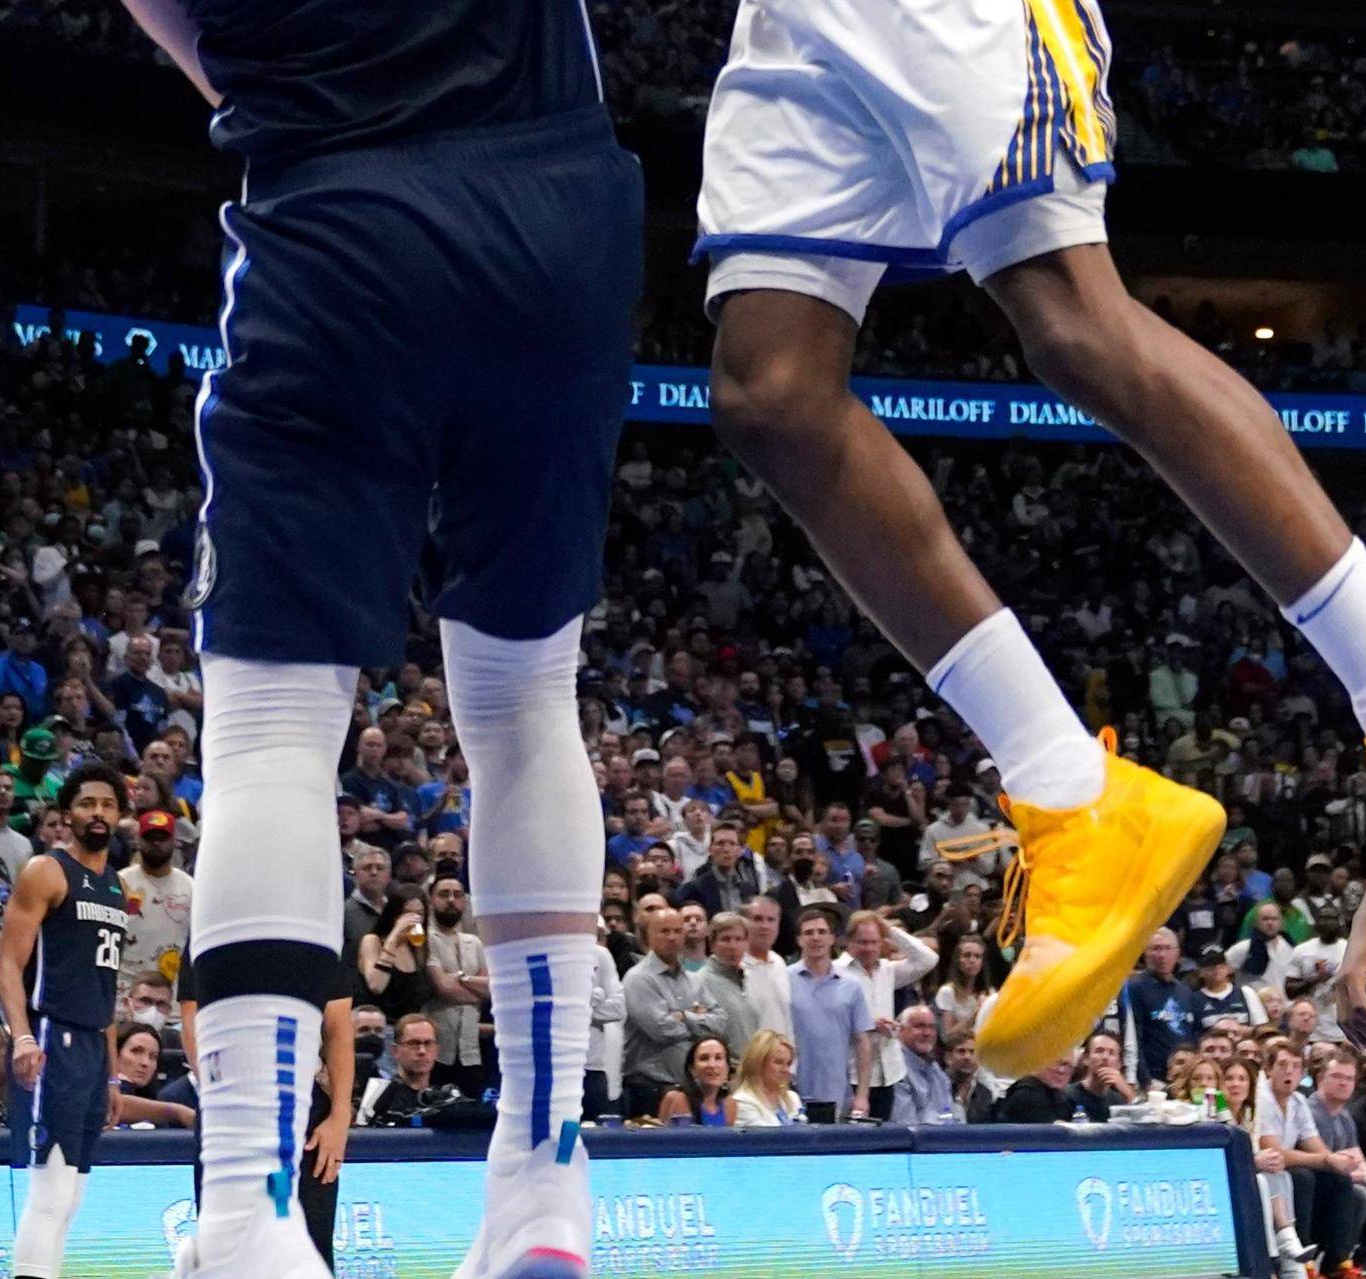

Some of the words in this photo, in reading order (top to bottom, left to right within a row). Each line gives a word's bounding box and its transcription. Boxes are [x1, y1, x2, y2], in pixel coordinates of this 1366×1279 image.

[871, 394, 996, 423] MARILOFF
[96, 928, 122, 970] 26
[869, 1186, 988, 1231] FANDUEL
[1117, 1179, 1219, 1220] FANDUEL
